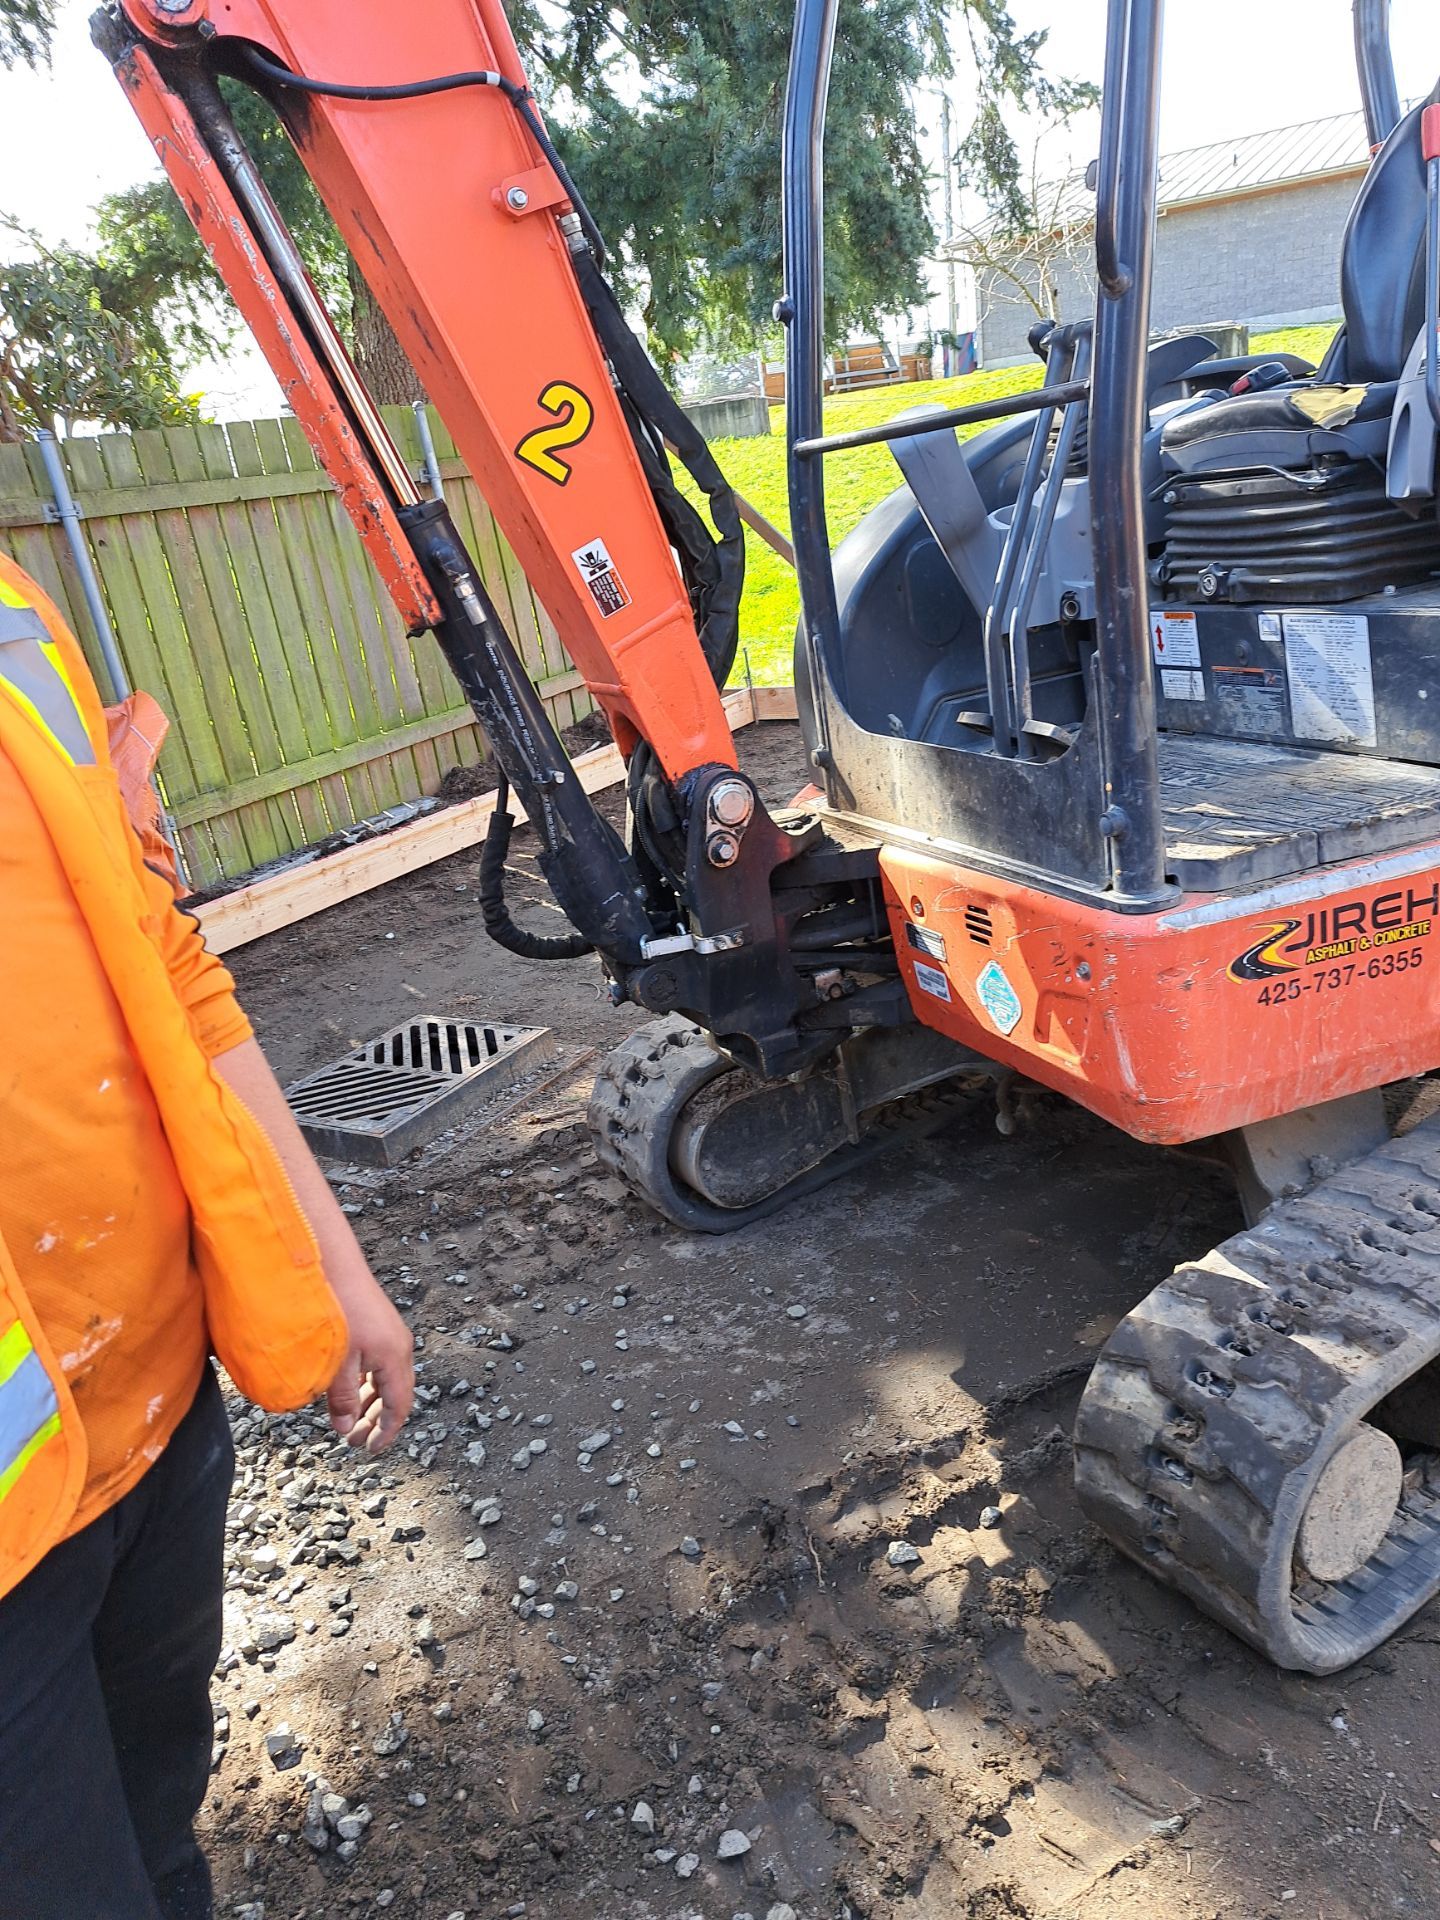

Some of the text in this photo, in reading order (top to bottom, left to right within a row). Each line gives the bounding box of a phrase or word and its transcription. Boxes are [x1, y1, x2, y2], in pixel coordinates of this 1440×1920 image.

[514, 380, 594, 487] 2
[1285, 883, 1439, 952] JIREH
[1305, 920, 1431, 965] ASPHALT & CONCRETE
[1257, 947, 1423, 1006] 425-737-6355
